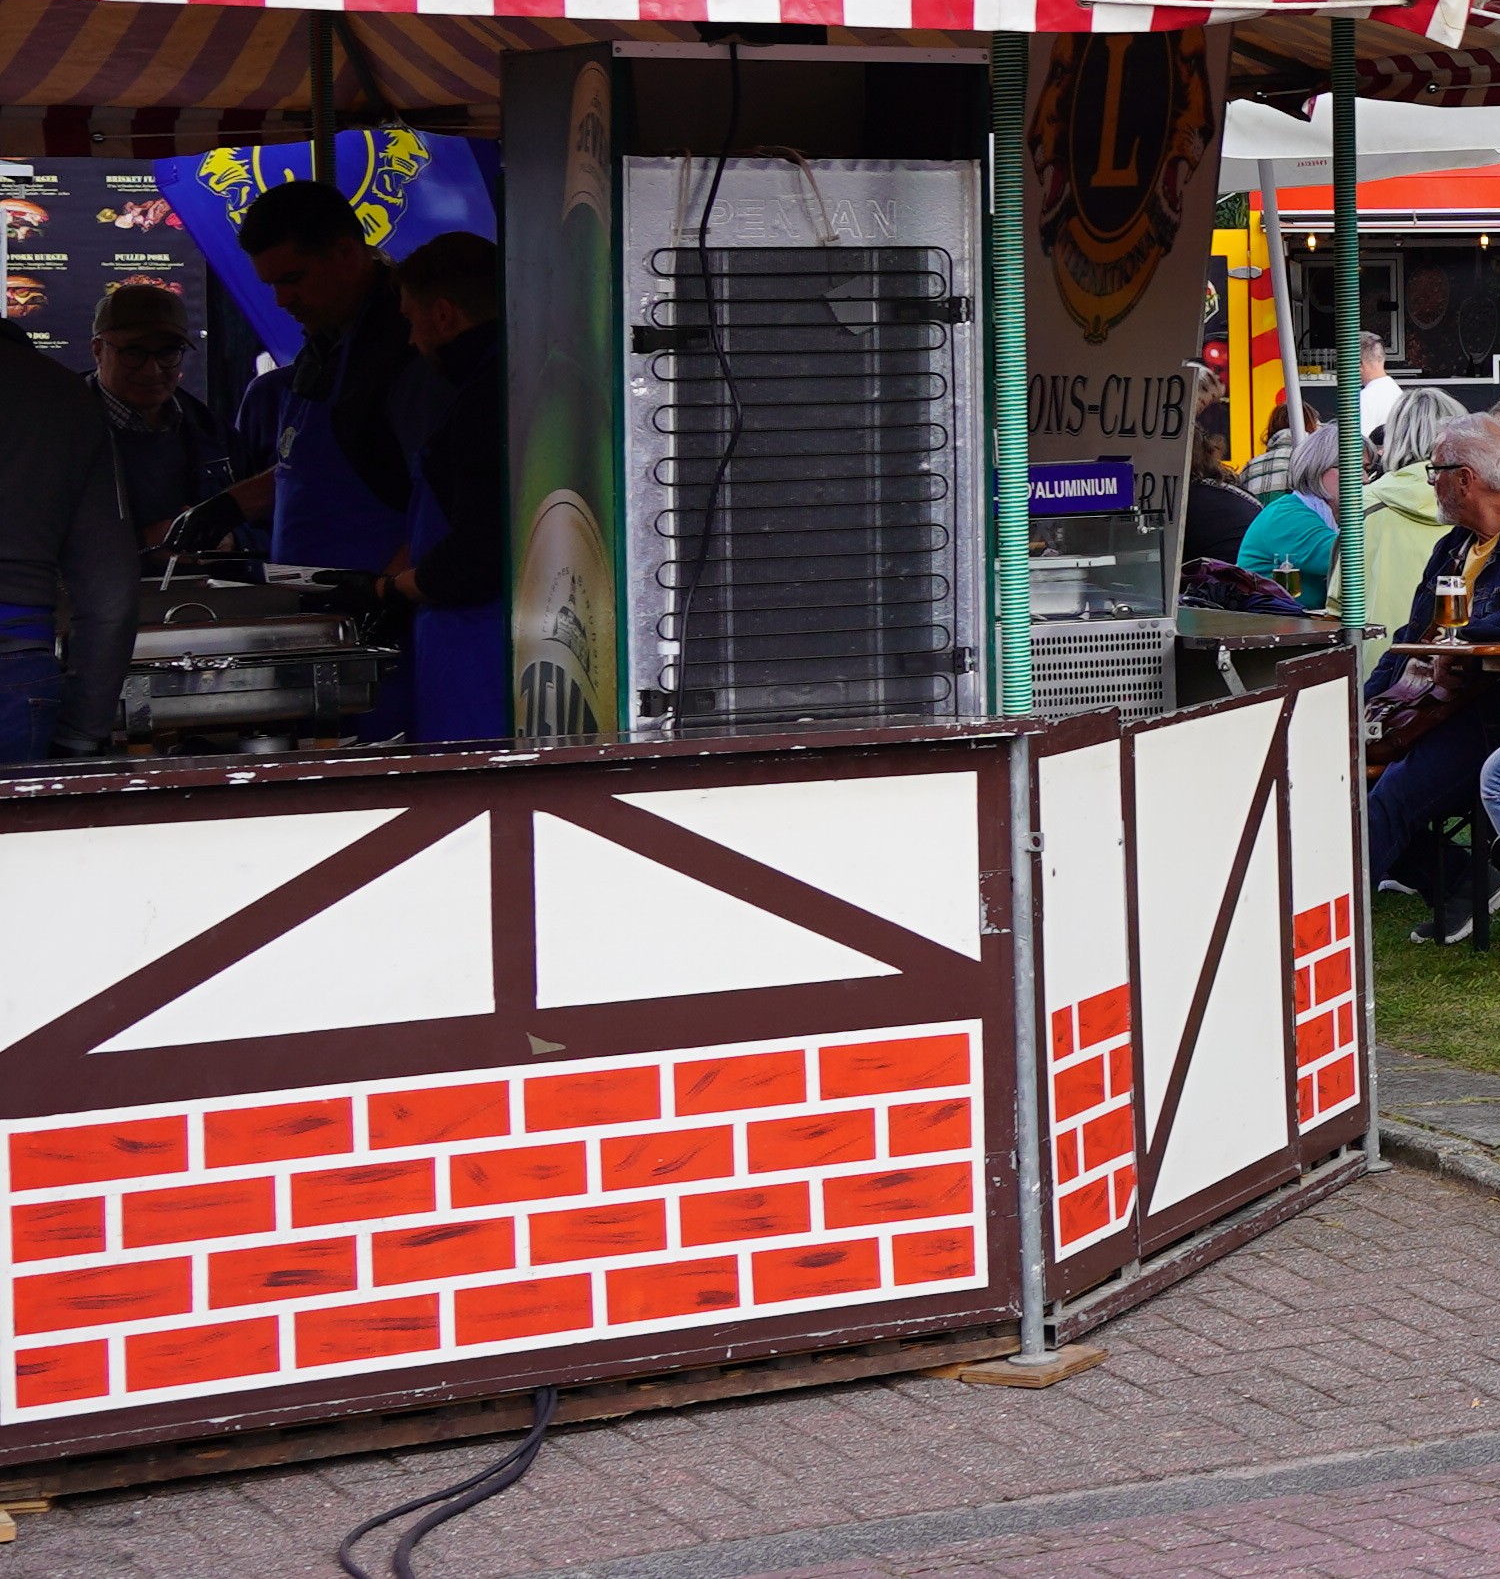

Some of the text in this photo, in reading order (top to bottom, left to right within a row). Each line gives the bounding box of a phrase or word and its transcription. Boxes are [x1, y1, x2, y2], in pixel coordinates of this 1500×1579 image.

[106, 175, 142, 183] BRISKET
[11, 253, 69, 262] PORK BURGER
[114, 253, 171, 262] PULLED PORK
[32, 331, 51, 340] DOG
[1026, 373, 1186, 440] ONS-CLUB
